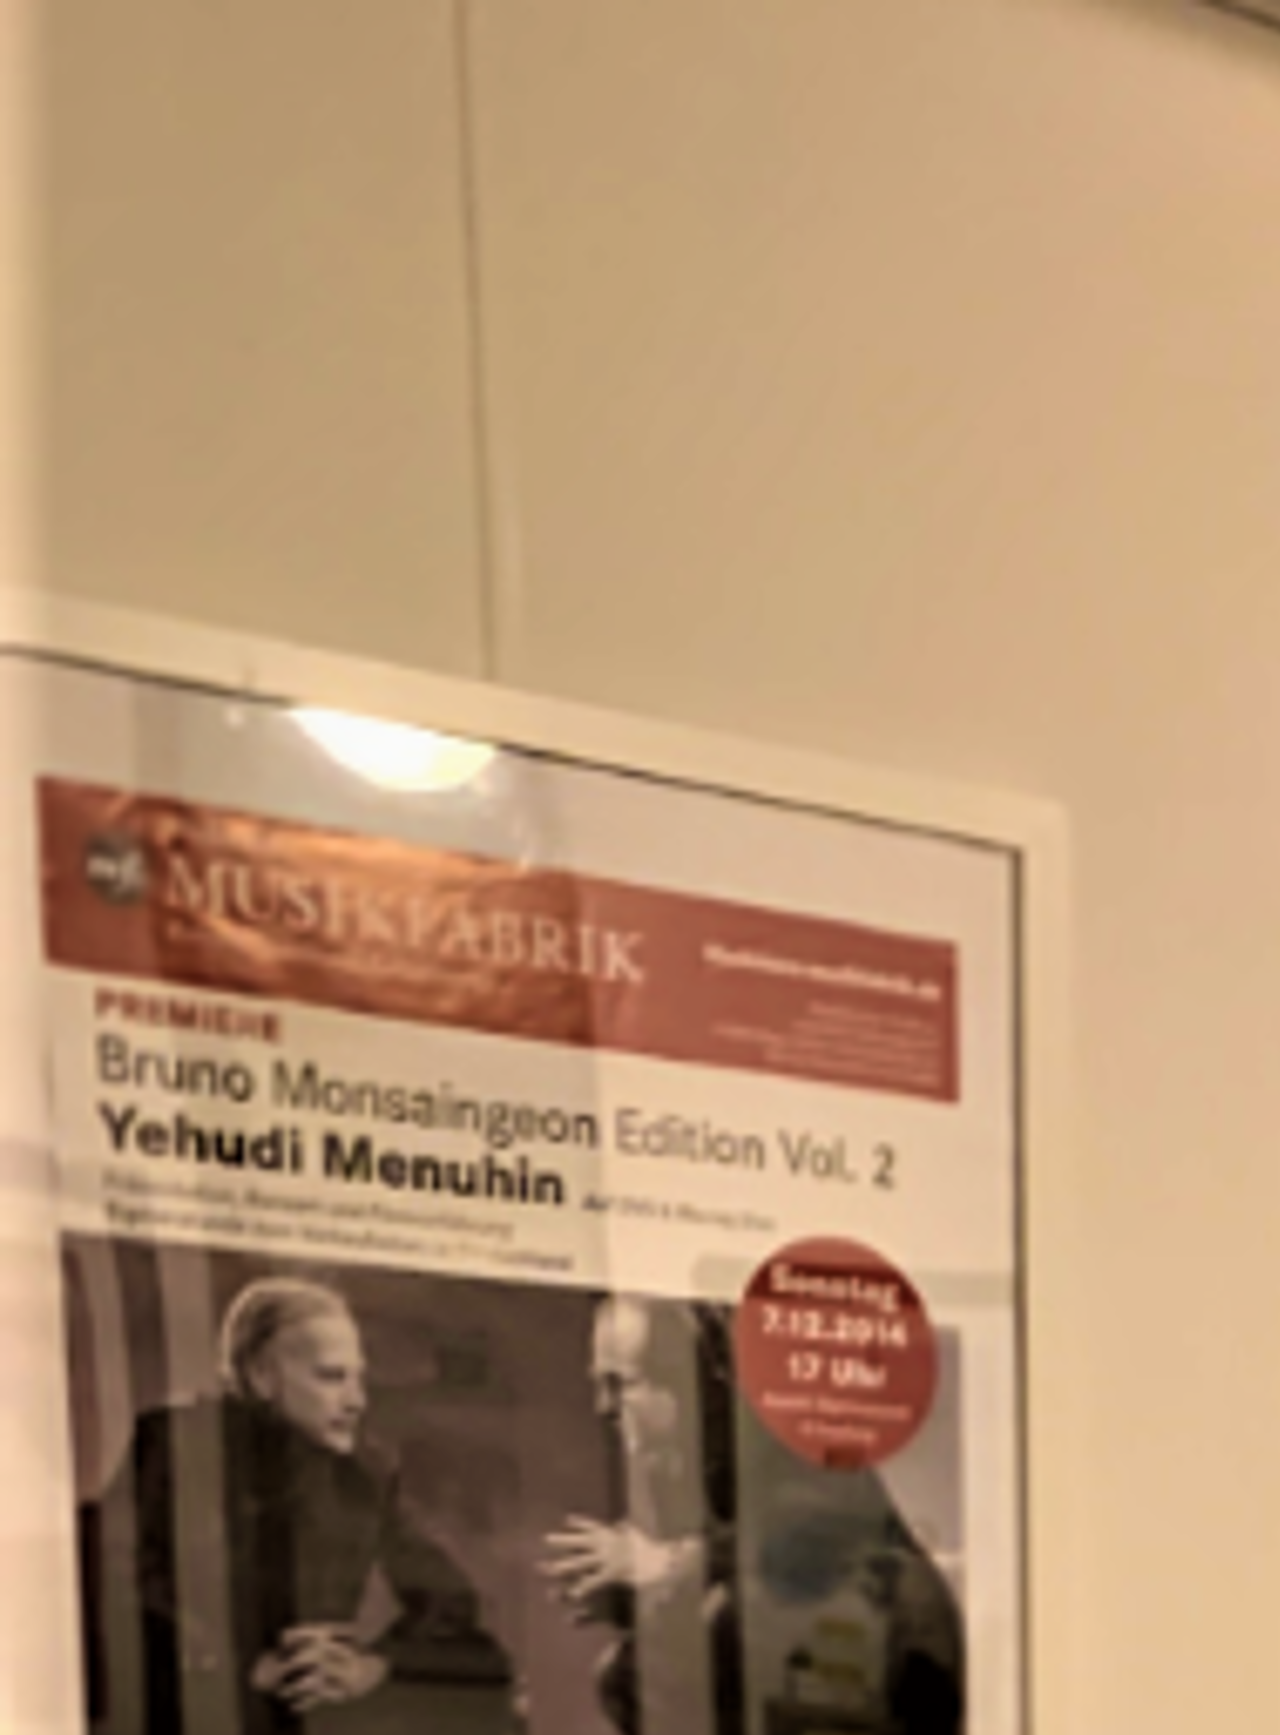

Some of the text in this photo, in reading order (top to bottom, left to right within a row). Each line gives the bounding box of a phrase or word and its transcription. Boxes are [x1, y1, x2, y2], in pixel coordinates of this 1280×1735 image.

[164, 857, 646, 984] MUSIKFABRIK
[95, 989, 279, 1044] PREMIERE
[96, 1033, 896, 1190] Bruno Monsaingeon Edition Vol. 2
[97, 1101, 305, 1175] Yehudi
[322, 1131, 565, 1206] Menuhin
